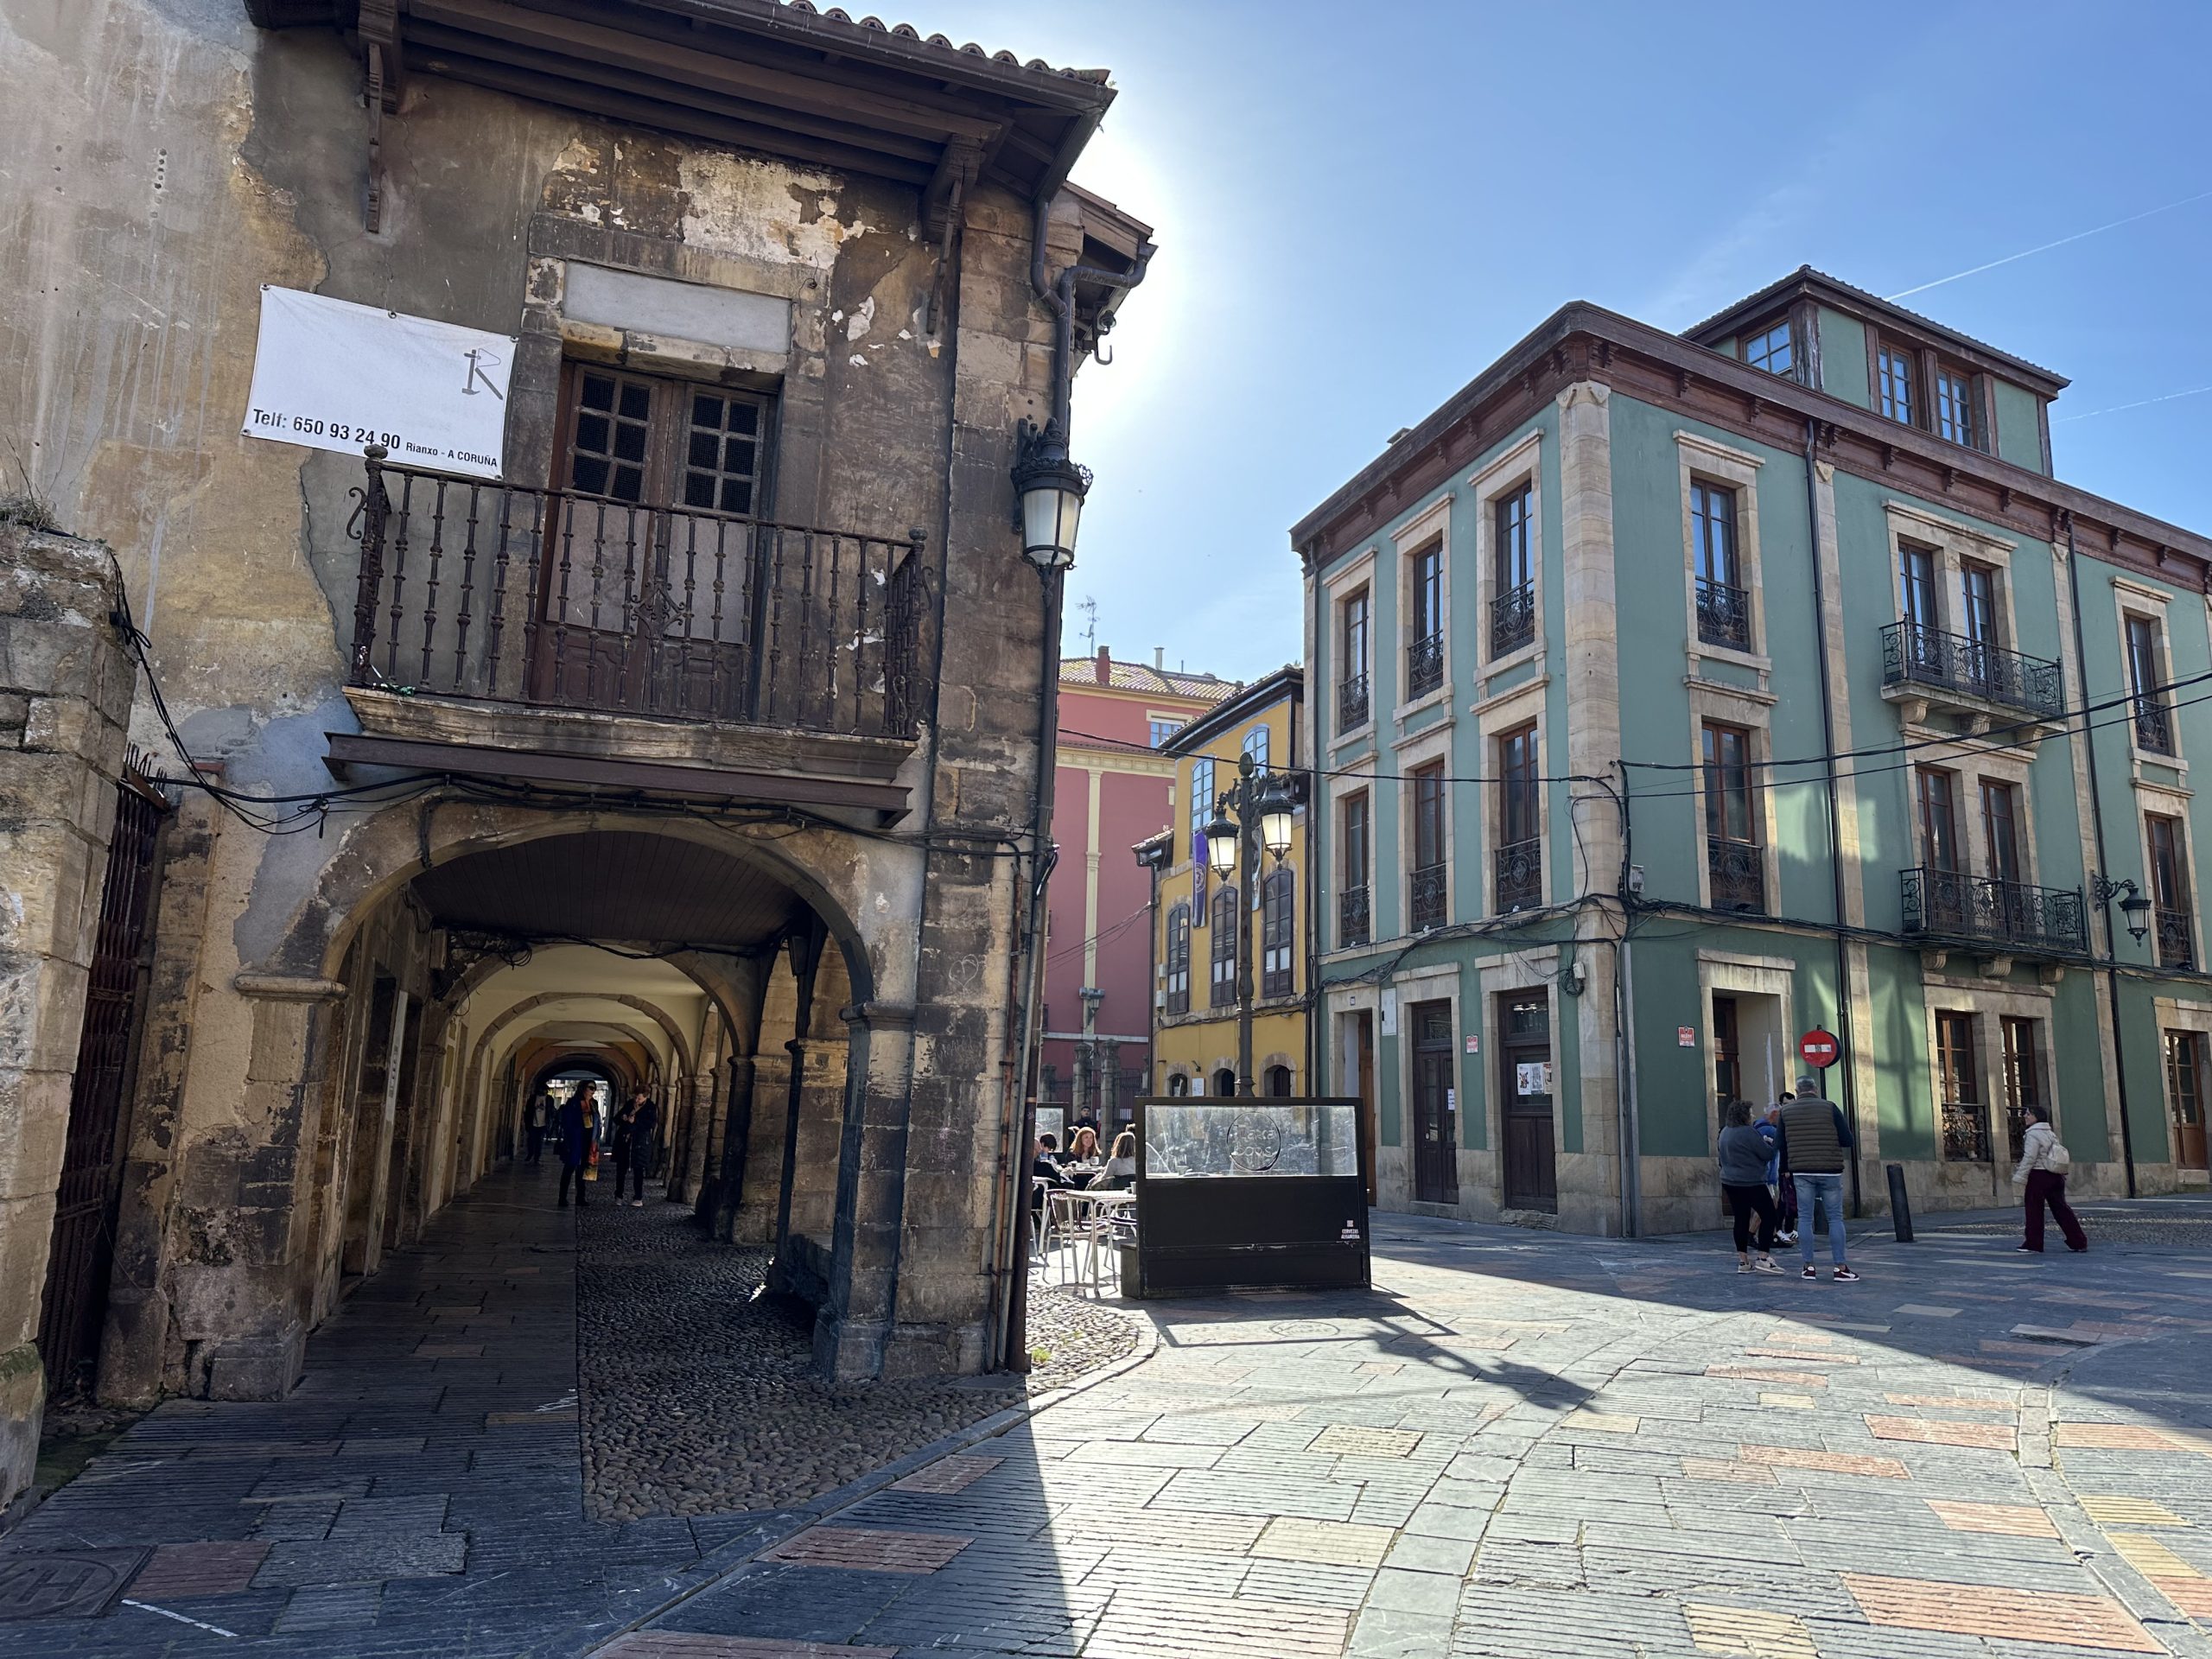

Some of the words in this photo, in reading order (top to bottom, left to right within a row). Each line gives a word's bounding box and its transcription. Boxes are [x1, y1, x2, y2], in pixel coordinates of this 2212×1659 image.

[253, 409, 287, 428] Telf:
[293, 416, 324, 435] 650
[330, 423, 349, 440] 93
[355, 428, 375, 444] 24
[381, 433, 400, 449] 90
[406, 442, 438, 456] Rianxo
[448, 449, 454, 459] A
[457, 451, 498, 467] CORUÑA
